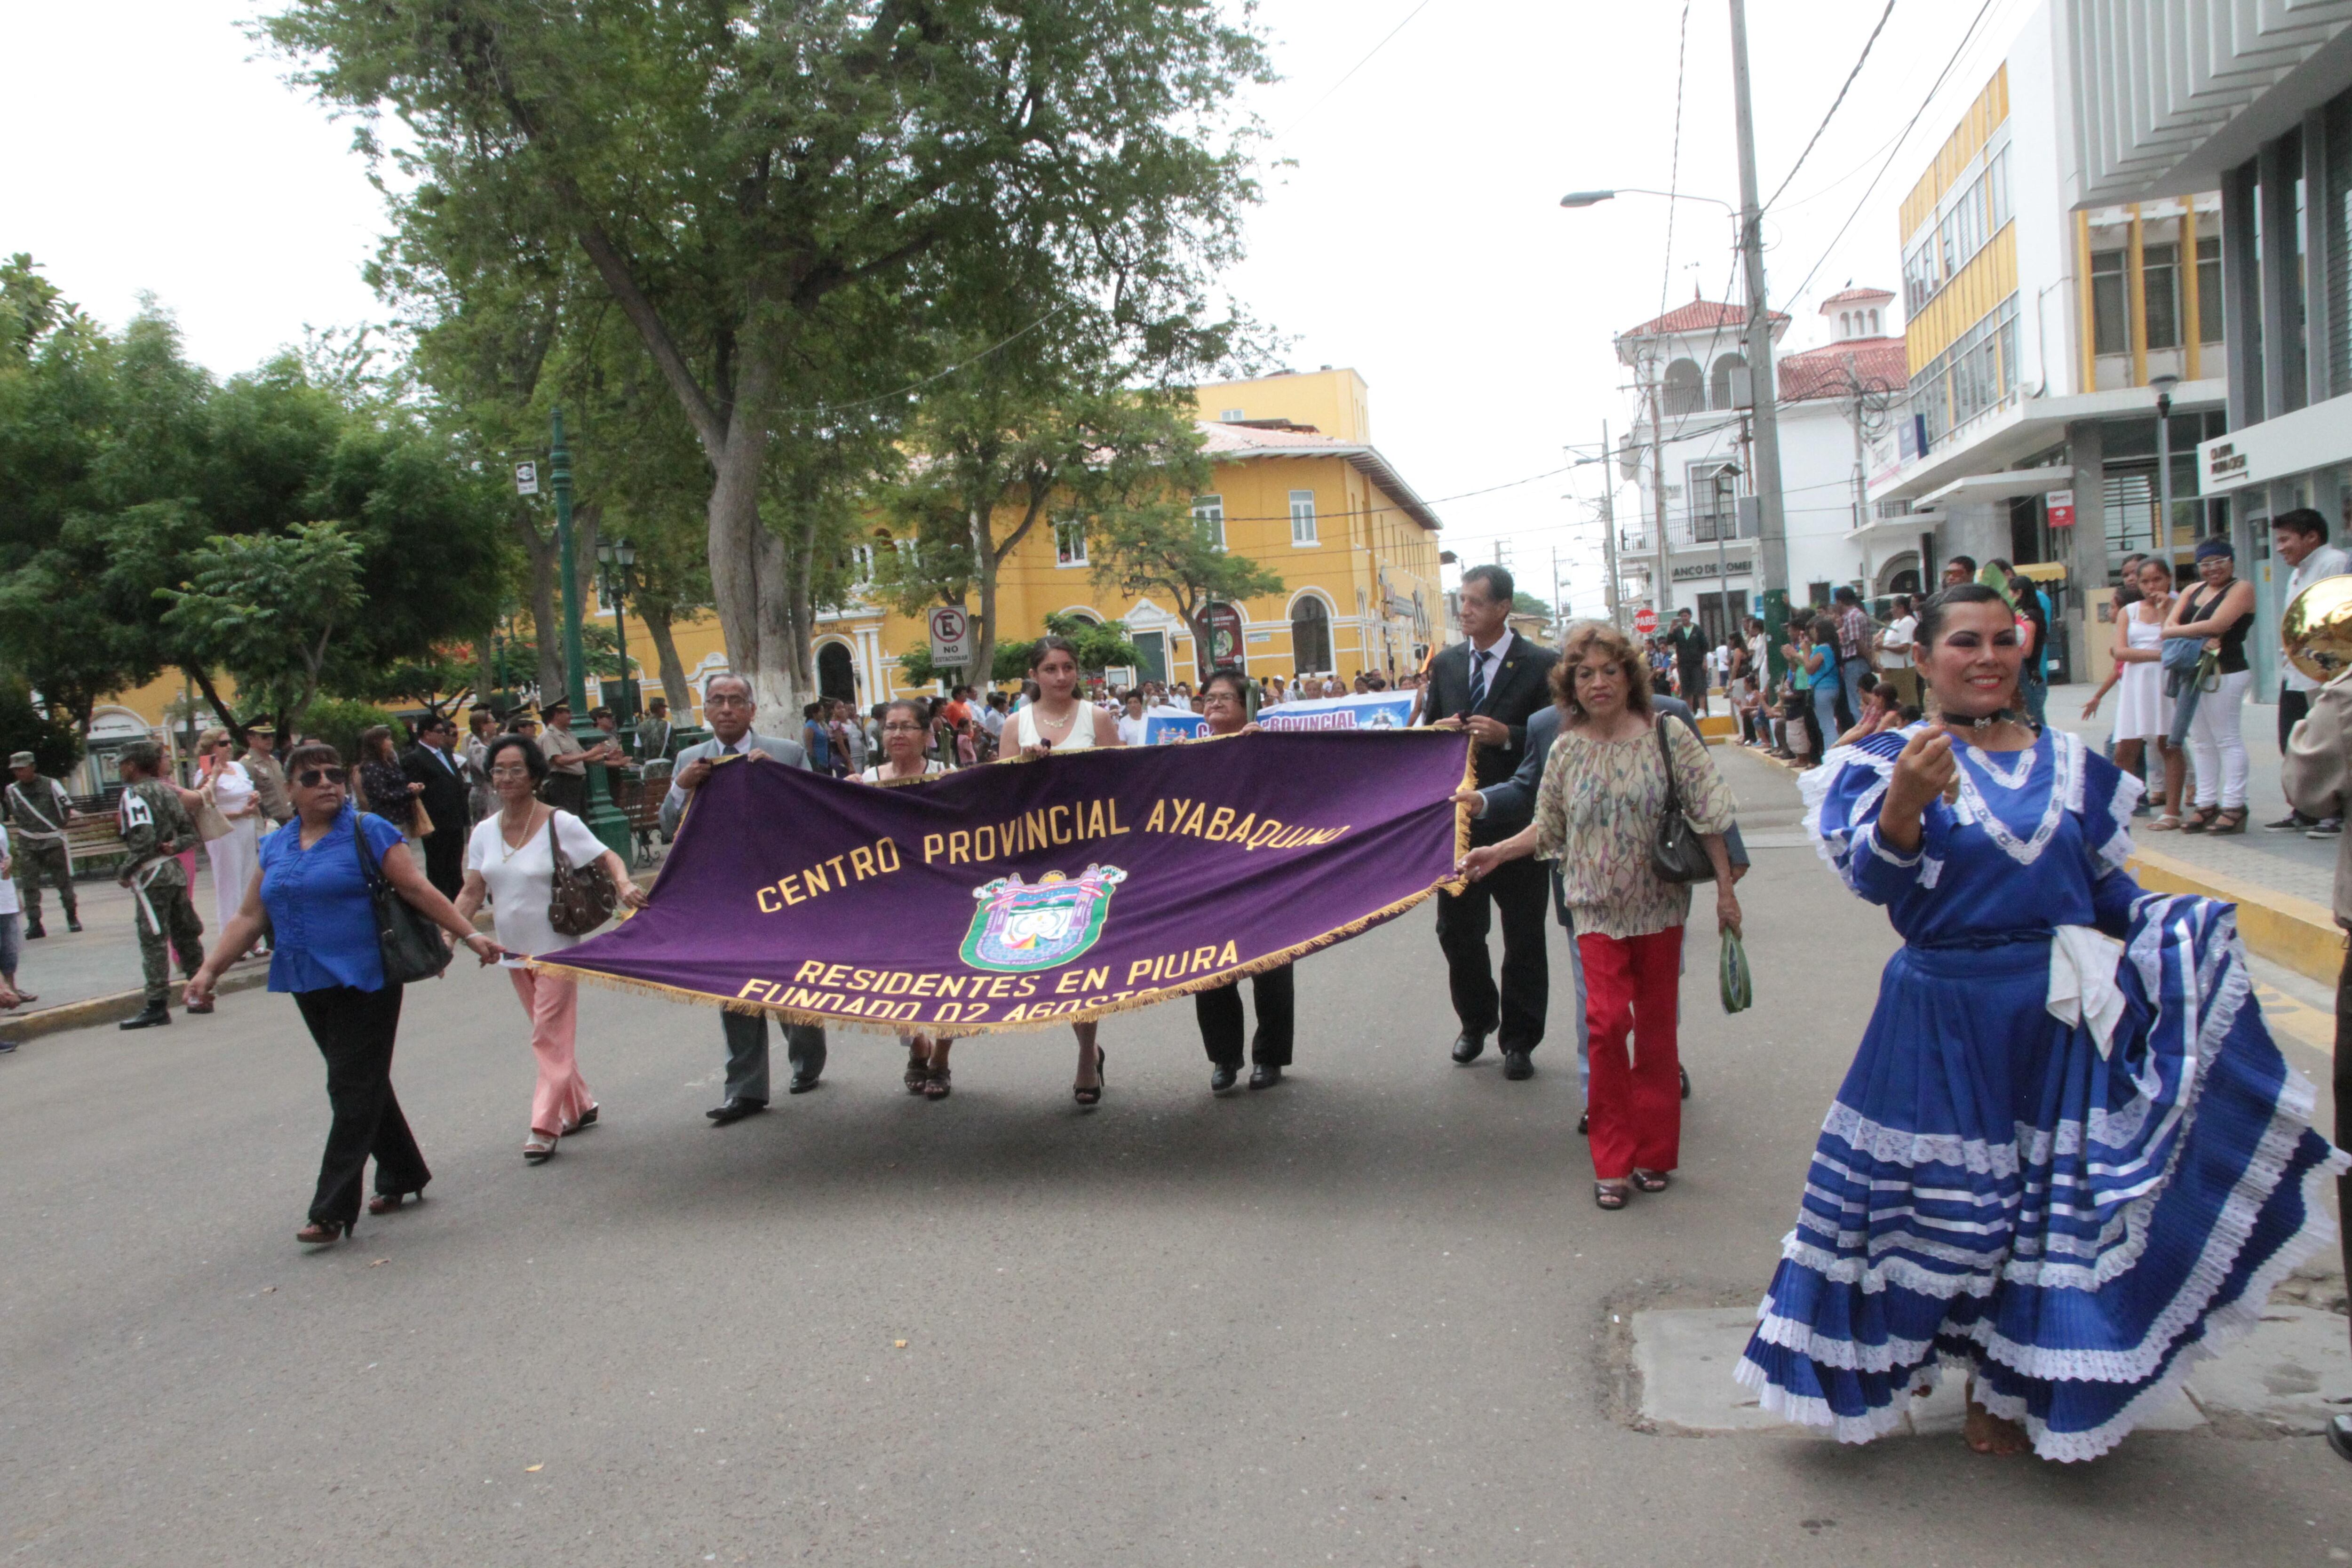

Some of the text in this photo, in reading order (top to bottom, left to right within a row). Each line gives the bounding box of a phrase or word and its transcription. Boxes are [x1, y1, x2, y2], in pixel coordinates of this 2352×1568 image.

[1671, 566, 1702, 576] ANCO
[1635, 615, 1656, 626] PARE
[132, 805, 149, 821] M
[757, 798, 1350, 913] CENTRO PROVINCIAL AYABAQUINO
[795, 940, 1238, 998] RESIDENTES EN PIURA
[737, 979, 922, 1020] FUNDADO
[933, 1003, 990, 1021] 02
